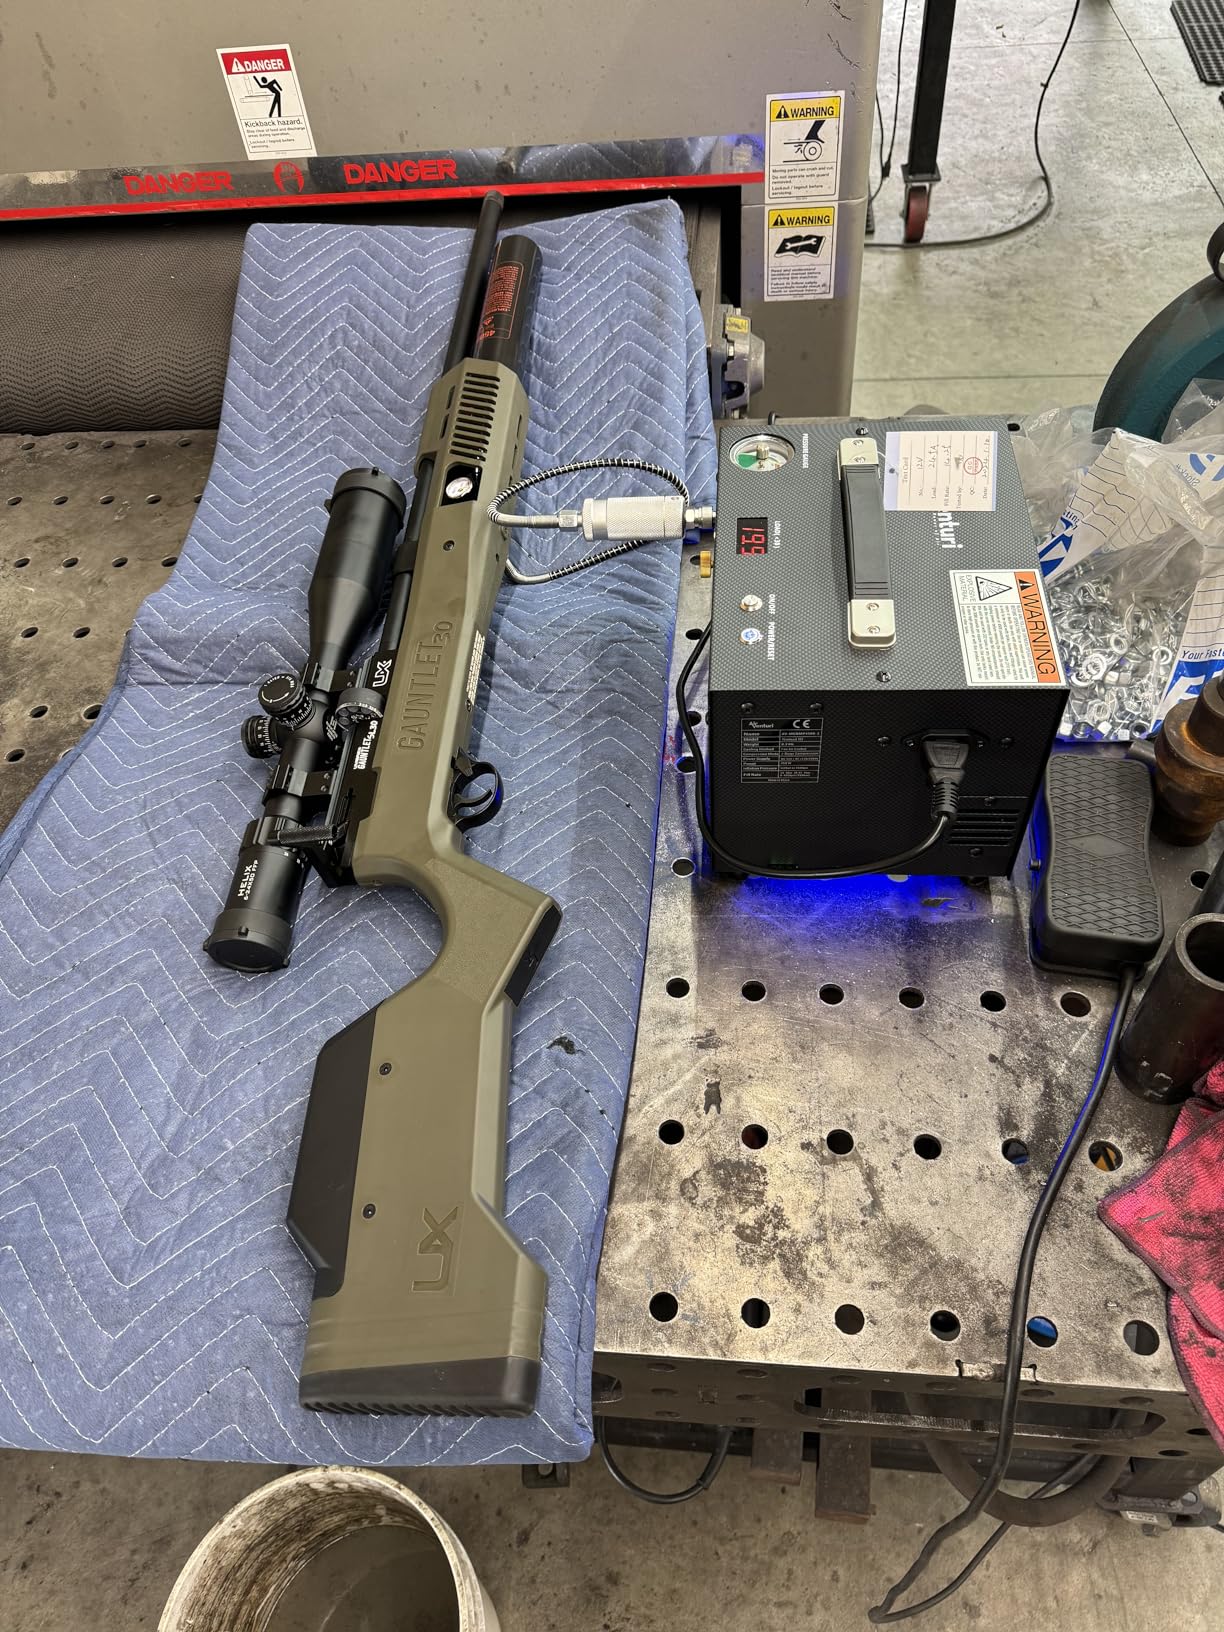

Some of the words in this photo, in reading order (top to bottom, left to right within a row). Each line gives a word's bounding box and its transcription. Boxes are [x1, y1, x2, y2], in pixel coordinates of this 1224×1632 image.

[244, 58, 285, 72] DANGER
[245, 119, 276, 128] Kickback
[277, 117, 303, 126] hazard.
[790, 105, 835, 119] WARNING
[122, 170, 235, 196] DANGER
[343, 159, 459, 185] DANGER
[786, 214, 831, 226] WARNING
[938, 511, 963, 549] nturi
[959, 575, 969, 602] MATERIAL
[965, 574, 977, 603] EXPLOSIVE
[768, 593, 776, 615] ON/OFF
[767, 621, 775, 661] POWER/RESET
[1021, 593, 1056, 675] WARNING
[1182, 650, 1203, 660] Your
[397, 641, 446, 750] GAUNTLET
[432, 620, 454, 647] 30
[357, 737, 372, 770] GAUNTLET
[237, 864, 253, 897] HELIX
